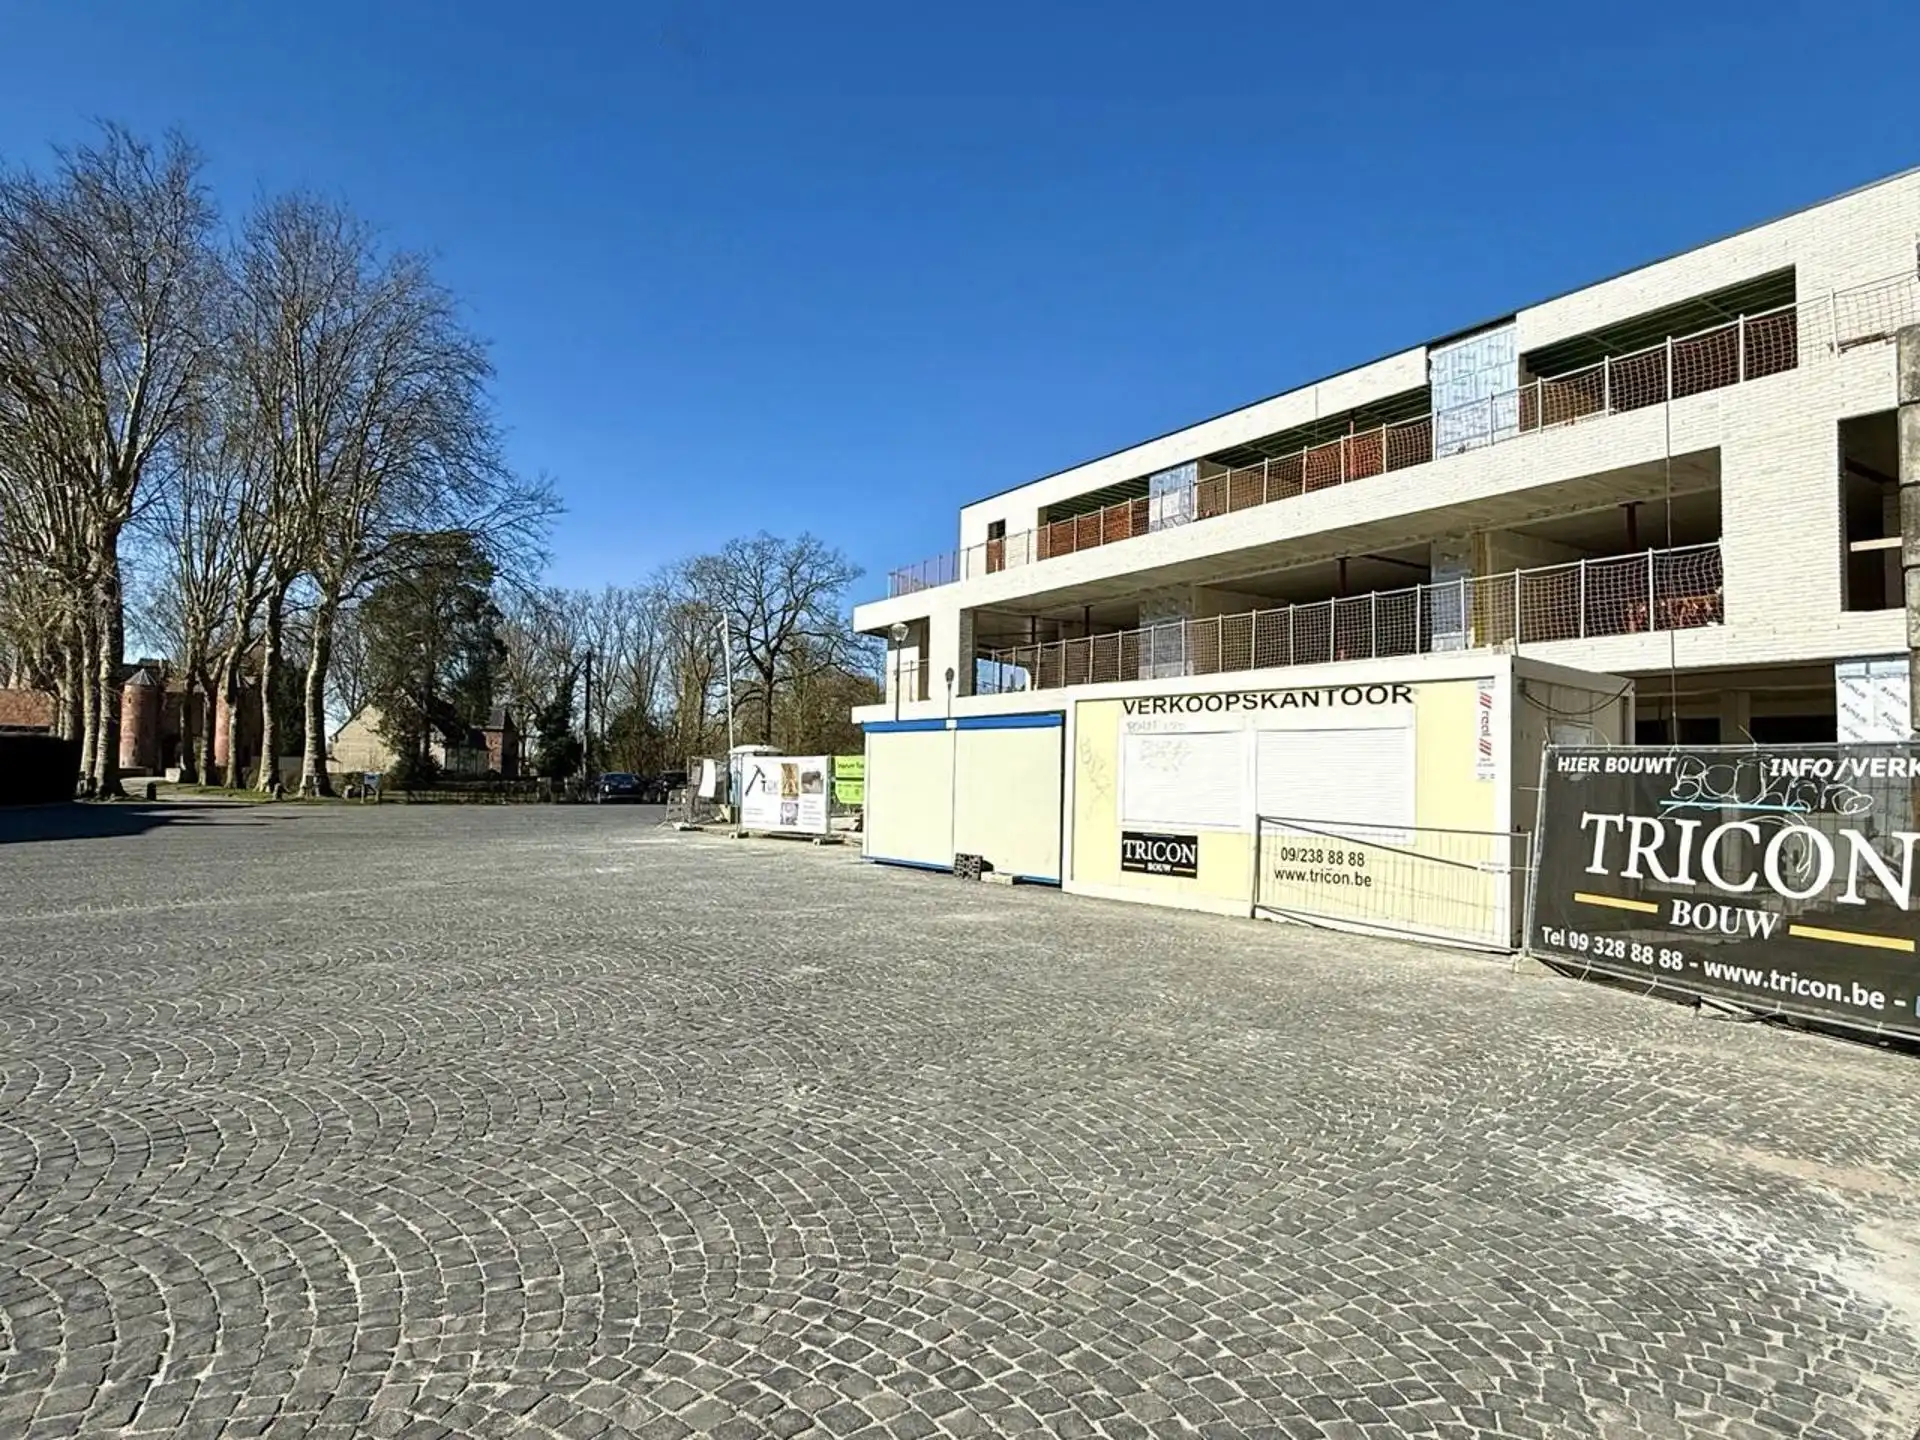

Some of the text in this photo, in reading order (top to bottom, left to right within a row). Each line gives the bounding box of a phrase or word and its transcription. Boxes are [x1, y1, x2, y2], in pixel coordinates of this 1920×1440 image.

[1122, 684, 1414, 715] VERKOOPSKANTOOR
[1557, 756, 1676, 774] HIER BOUWT
[1123, 839, 1197, 864] TRICON
[1281, 847, 1365, 867] 09/238 88 88
[1581, 811, 1920, 911] TRICON
[1147, 862, 1172, 873] BOUW
[1274, 868, 1372, 887] www.tricon.be
[1669, 899, 1780, 940] BOUW
[1542, 926, 1565, 946] Tel
[1568, 931, 1588, 951] 09
[1593, 936, 1625, 958] 328
[1631, 943, 1654, 965] 88
[1659, 949, 1683, 971] 88
[1704, 960, 1885, 1010] www.tricon.be
